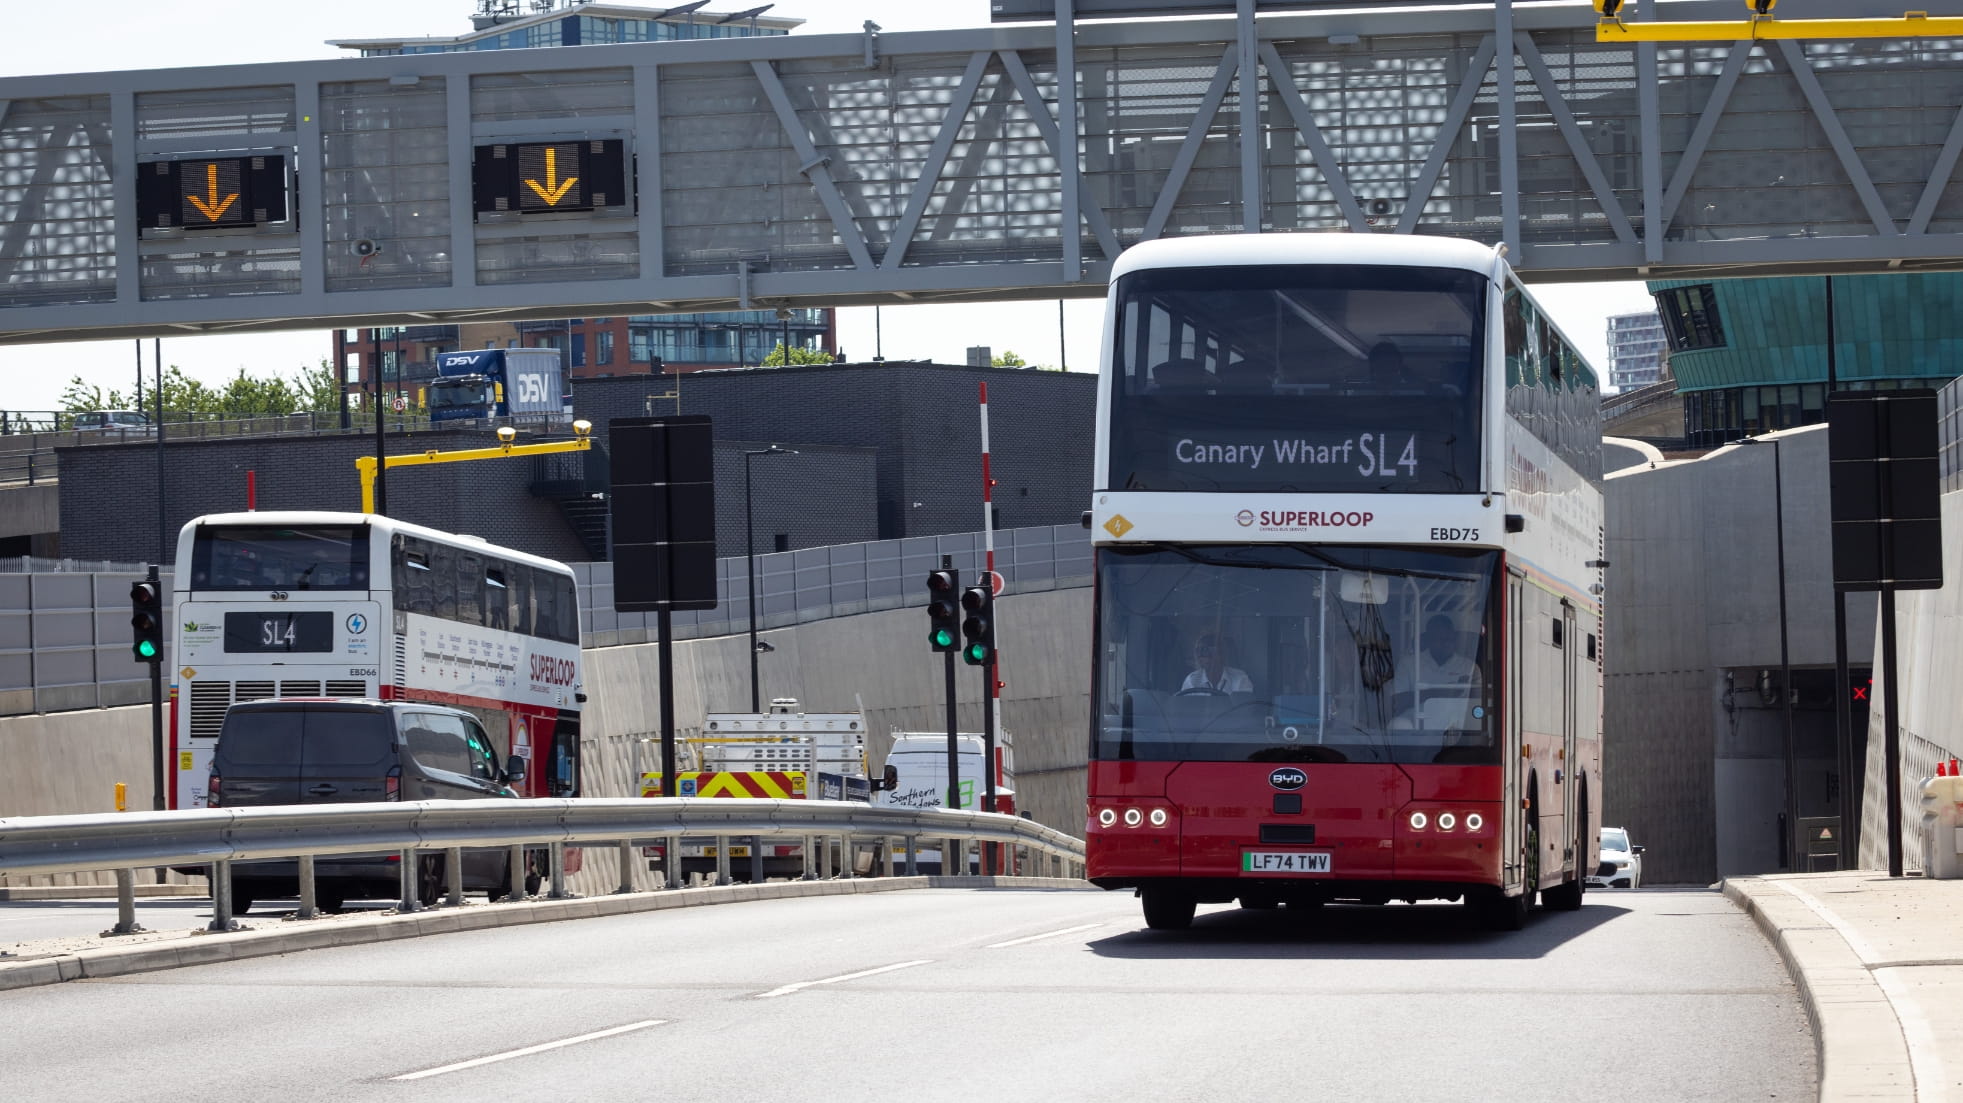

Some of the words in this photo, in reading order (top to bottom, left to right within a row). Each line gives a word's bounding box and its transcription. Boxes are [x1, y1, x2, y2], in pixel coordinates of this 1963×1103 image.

[446, 355, 480, 367] DSV
[518, 373, 549, 403] DSV
[1175, 439, 1264, 469] Canary
[1273, 439, 1353, 464] Wharf
[1358, 433, 1418, 477] SL4
[1260, 511, 1374, 527] SUPERLOOP
[1430, 528, 1479, 541] EBD75
[263, 620, 296, 645] SL4
[350, 668, 377, 676] EBD66
[530, 652, 575, 687] SUPERLOOP
[1272, 774, 1303, 784] BYD
[889, 787, 936, 805] Southern
[1253, 855, 1293, 870] LF74
[1298, 855, 1327, 870] TWV
